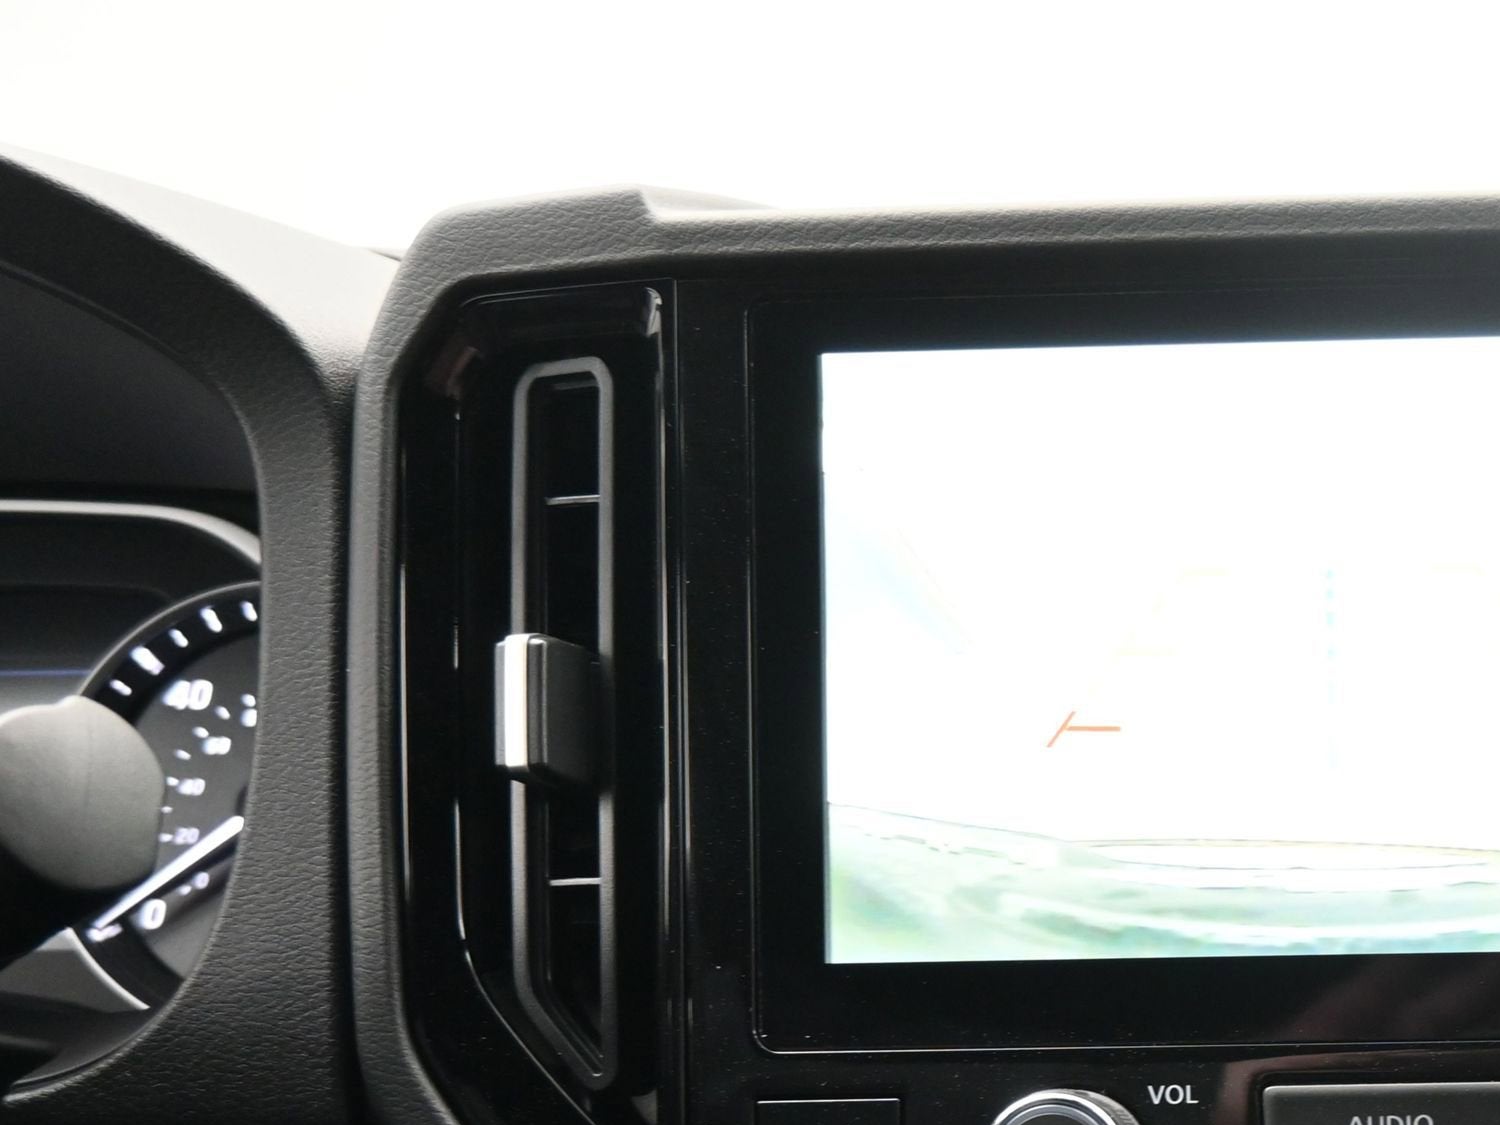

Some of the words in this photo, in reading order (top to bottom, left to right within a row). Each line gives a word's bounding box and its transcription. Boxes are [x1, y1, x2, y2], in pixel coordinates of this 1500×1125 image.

[163, 679, 213, 710] 40
[139, 899, 167, 930] 0
[1148, 1085, 1199, 1105] VOL
